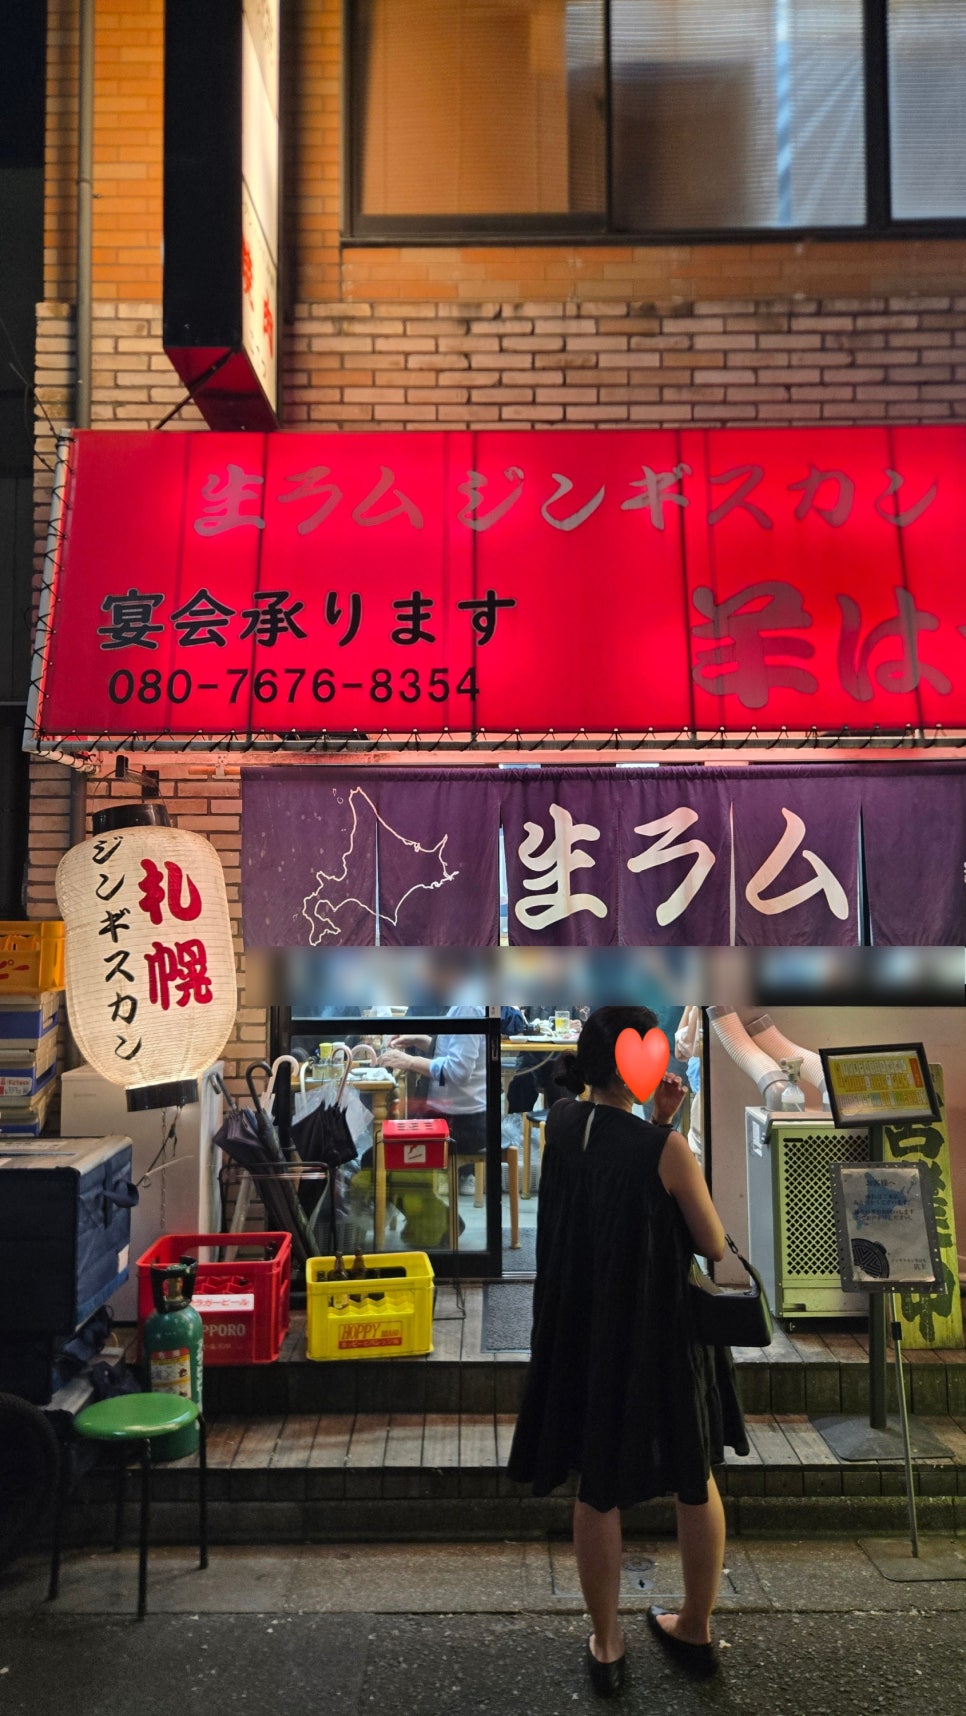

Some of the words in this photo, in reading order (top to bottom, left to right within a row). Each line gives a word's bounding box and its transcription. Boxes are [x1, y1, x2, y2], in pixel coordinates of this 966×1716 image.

[194, 464, 423, 537] 生ラム
[458, 463, 939, 531] ジンギスカン
[97, 588, 516, 651] 宴会承ります
[692, 580, 966, 709] 羊は
[108, 667, 480, 704] 080-7676-8354
[514, 803, 850, 931] 生ラム
[93, 835, 142, 1061] ジンギスカン
[138, 857, 213, 1011] 札幌
[191, 1298, 249, 1308] ラガービール
[203, 1323, 246, 1336] PPORO
[341, 1324, 381, 1340] HOPPY
